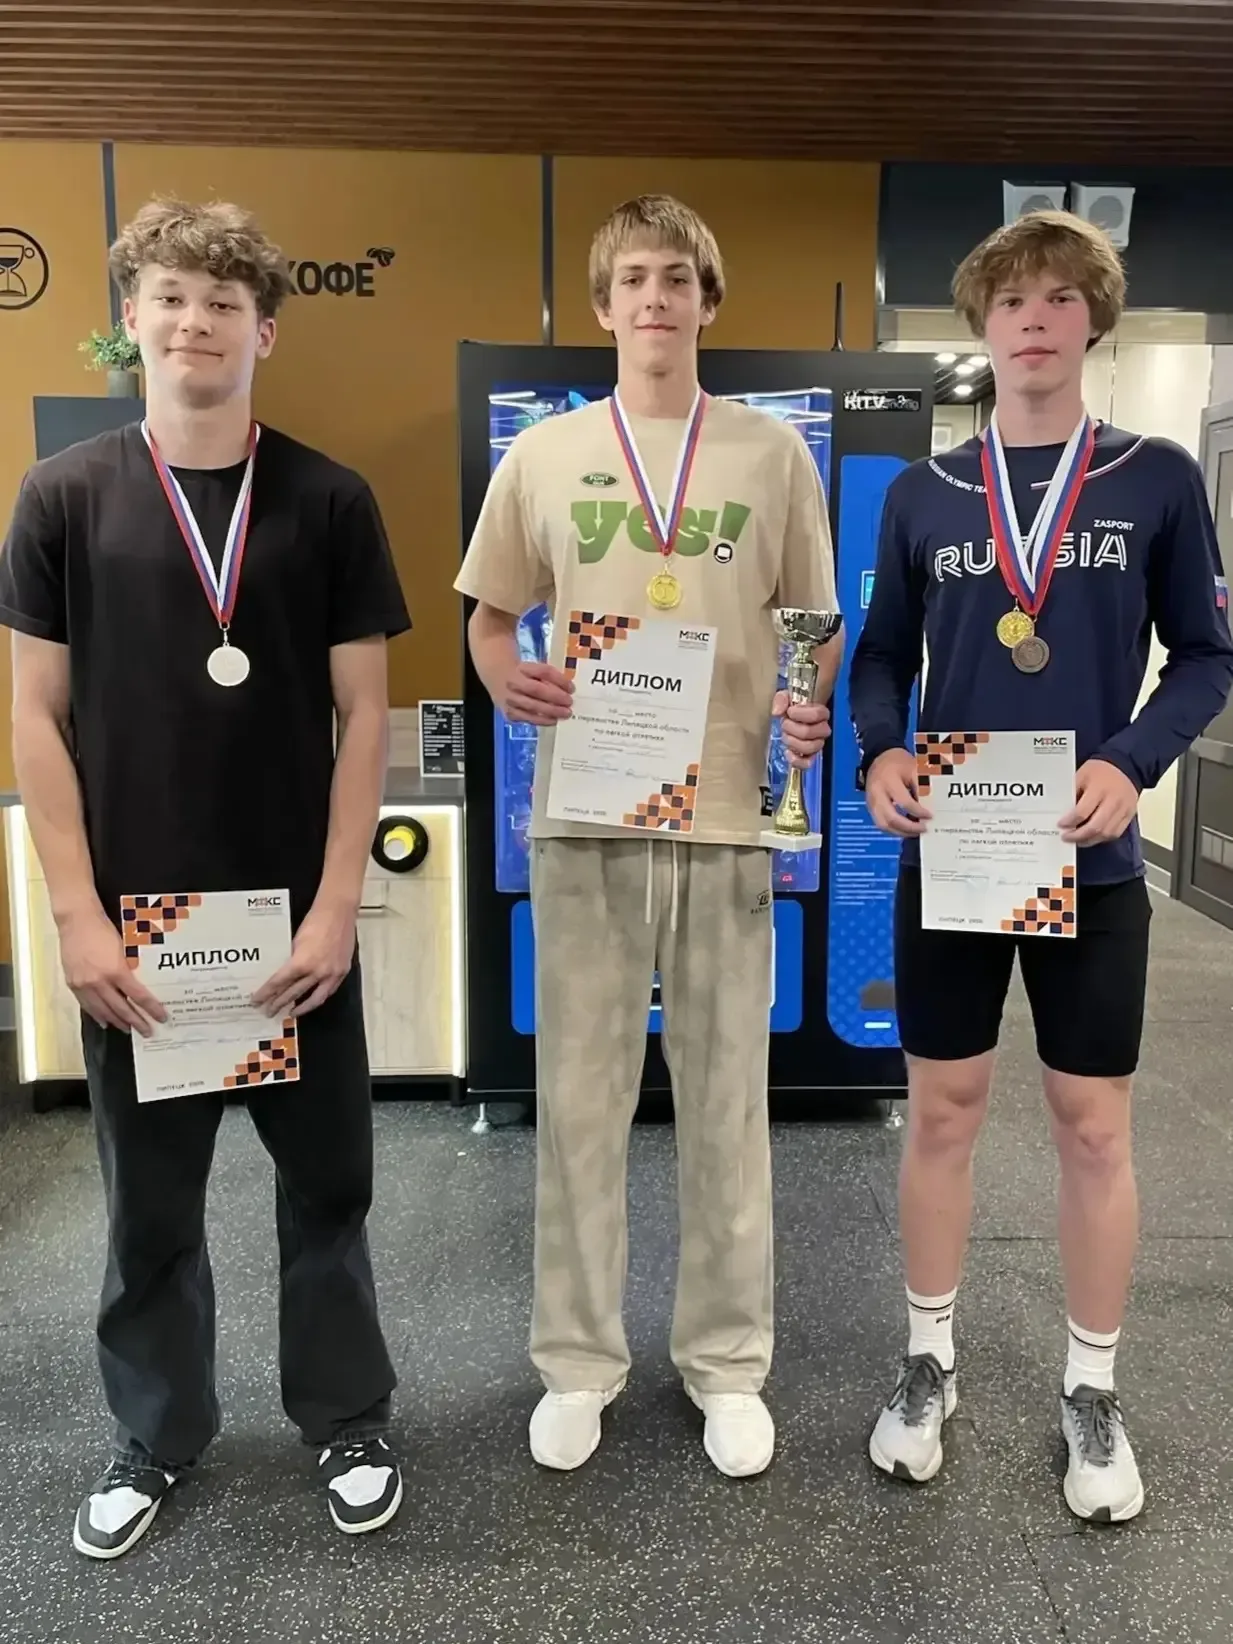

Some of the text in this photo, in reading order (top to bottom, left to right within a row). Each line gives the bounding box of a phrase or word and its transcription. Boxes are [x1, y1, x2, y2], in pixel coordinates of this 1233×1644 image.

[945, 474, 974, 491] OLYMPIC
[974, 485, 988, 493] TEA
[1093, 519, 1134, 531] ZASPORT
[934, 532, 1127, 583] RUSIA
[591, 669, 682, 692] ДИПЛОМ
[948, 782, 1044, 799] ДИПЛОМ
[158, 948, 260, 970] ДИПЛОМ
